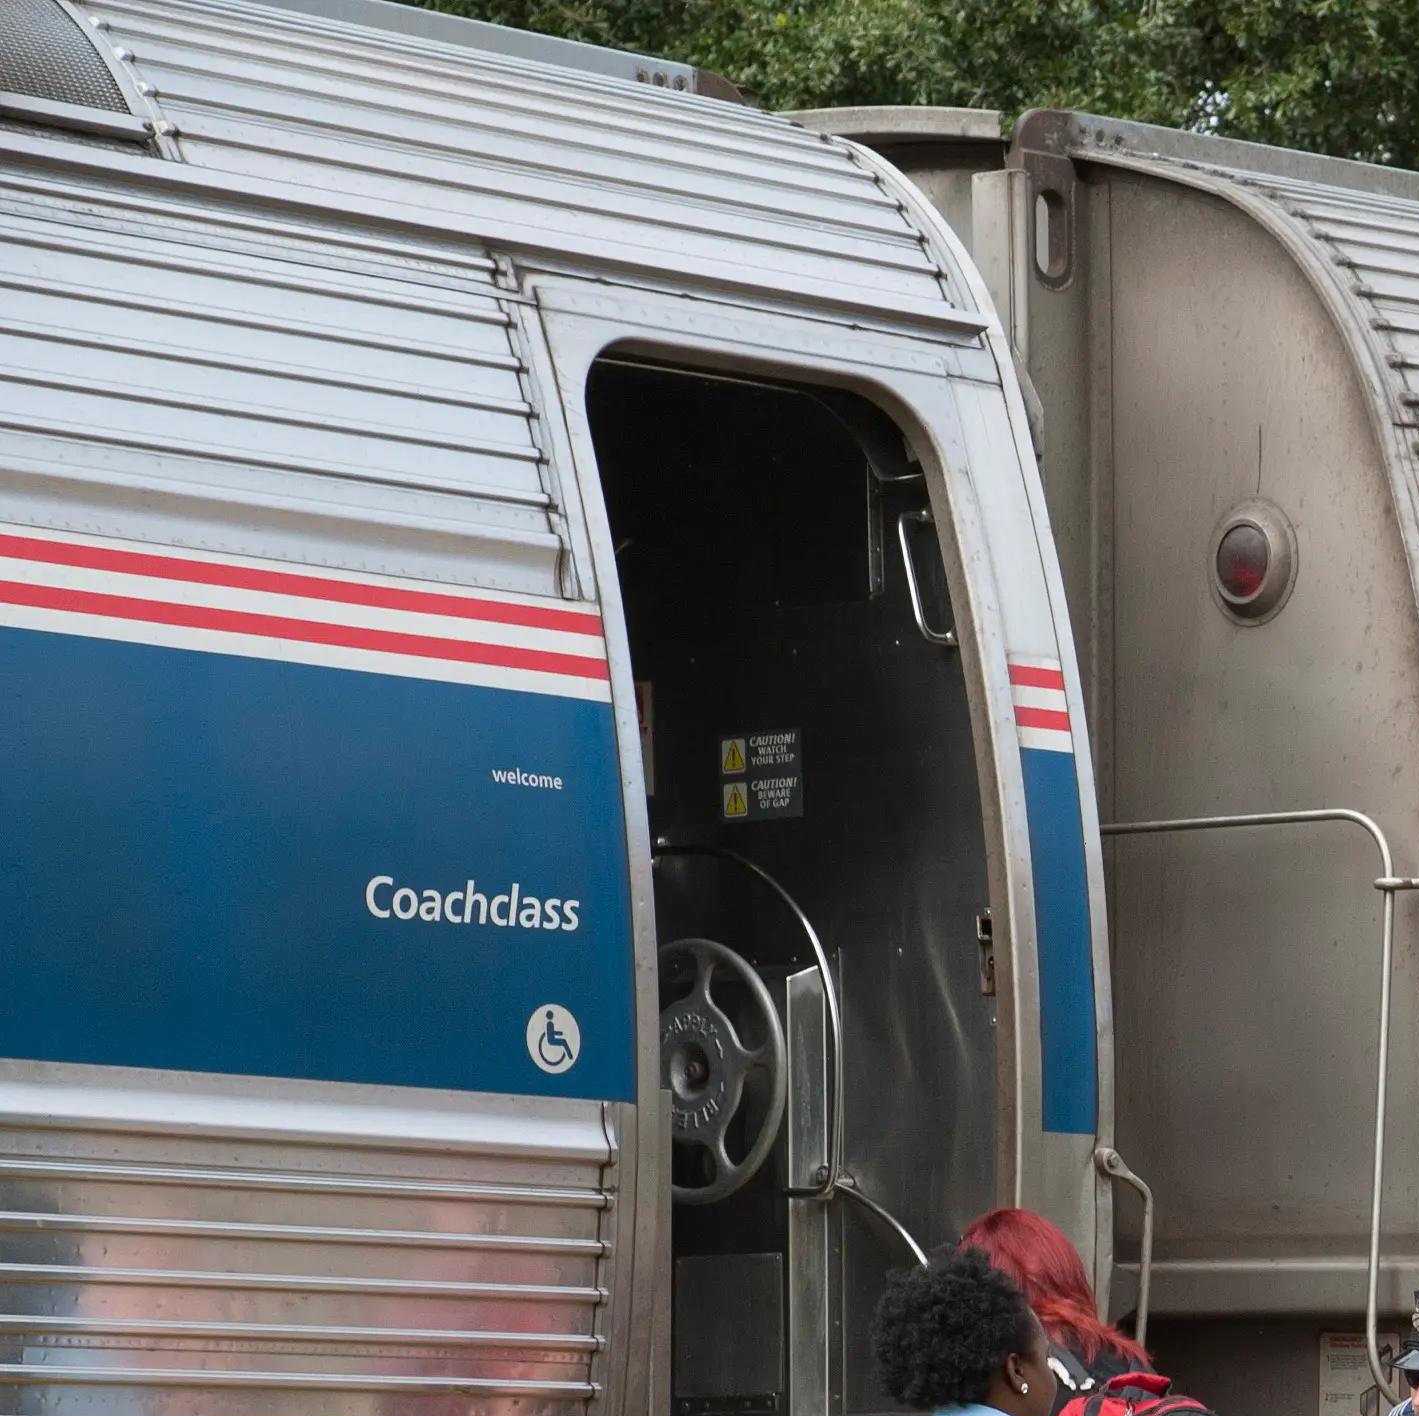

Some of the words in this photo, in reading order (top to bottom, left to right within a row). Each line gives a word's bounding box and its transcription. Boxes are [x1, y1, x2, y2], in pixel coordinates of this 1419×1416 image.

[749, 733, 796, 747] CAUTION!
[758, 744, 787, 755] WATCH
[751, 756, 774, 766] YOUR
[776, 753, 795, 763] STEP
[491, 766, 564, 790] welcome
[751, 777, 797, 790] CAUTION!
[758, 788, 791, 799] BEWARE
[760, 800, 770, 809] OF
[772, 798, 790, 808] GAP
[364, 874, 581, 932] Coachclass
